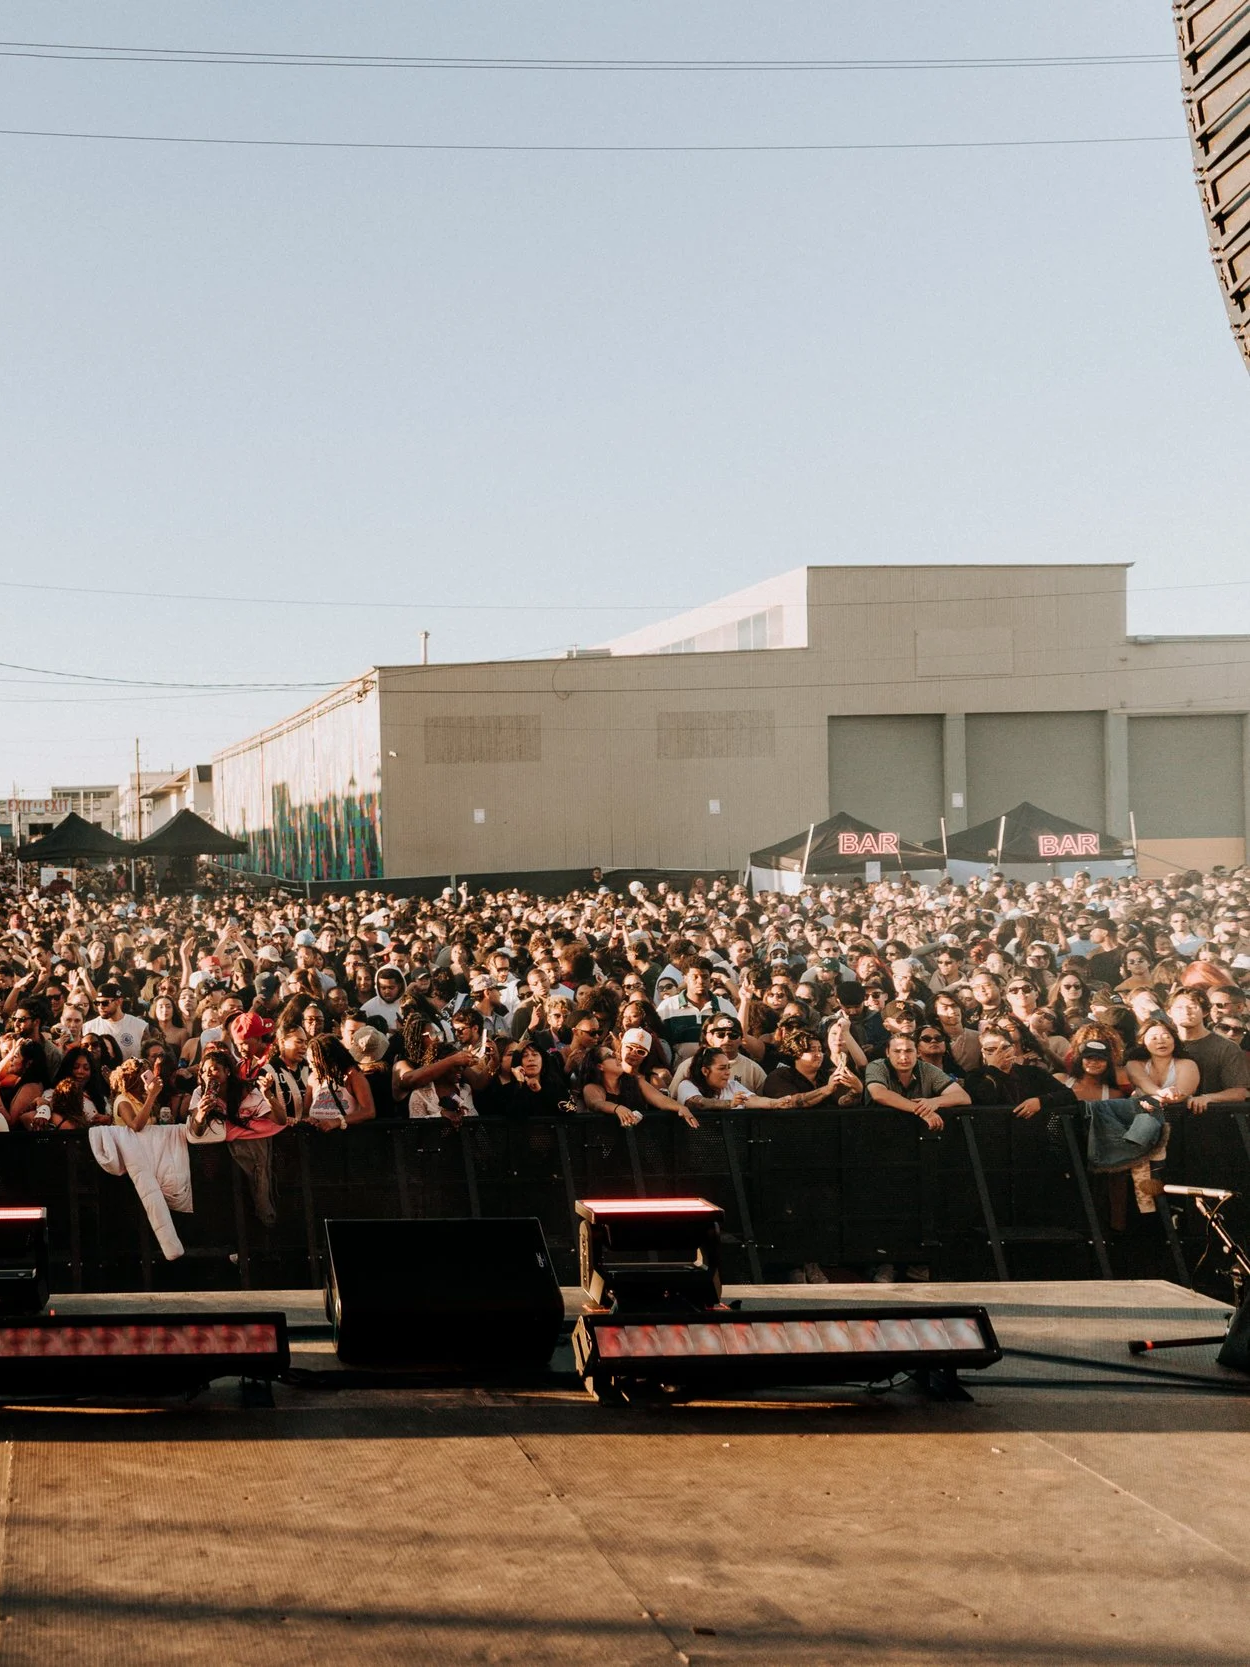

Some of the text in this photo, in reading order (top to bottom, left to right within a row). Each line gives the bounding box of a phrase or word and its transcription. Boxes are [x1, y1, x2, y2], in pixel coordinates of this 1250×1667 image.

[8, 799, 69, 813] EXIT EXIT
[839, 832, 899, 855] BAR
[1038, 833, 1099, 857] BAR
